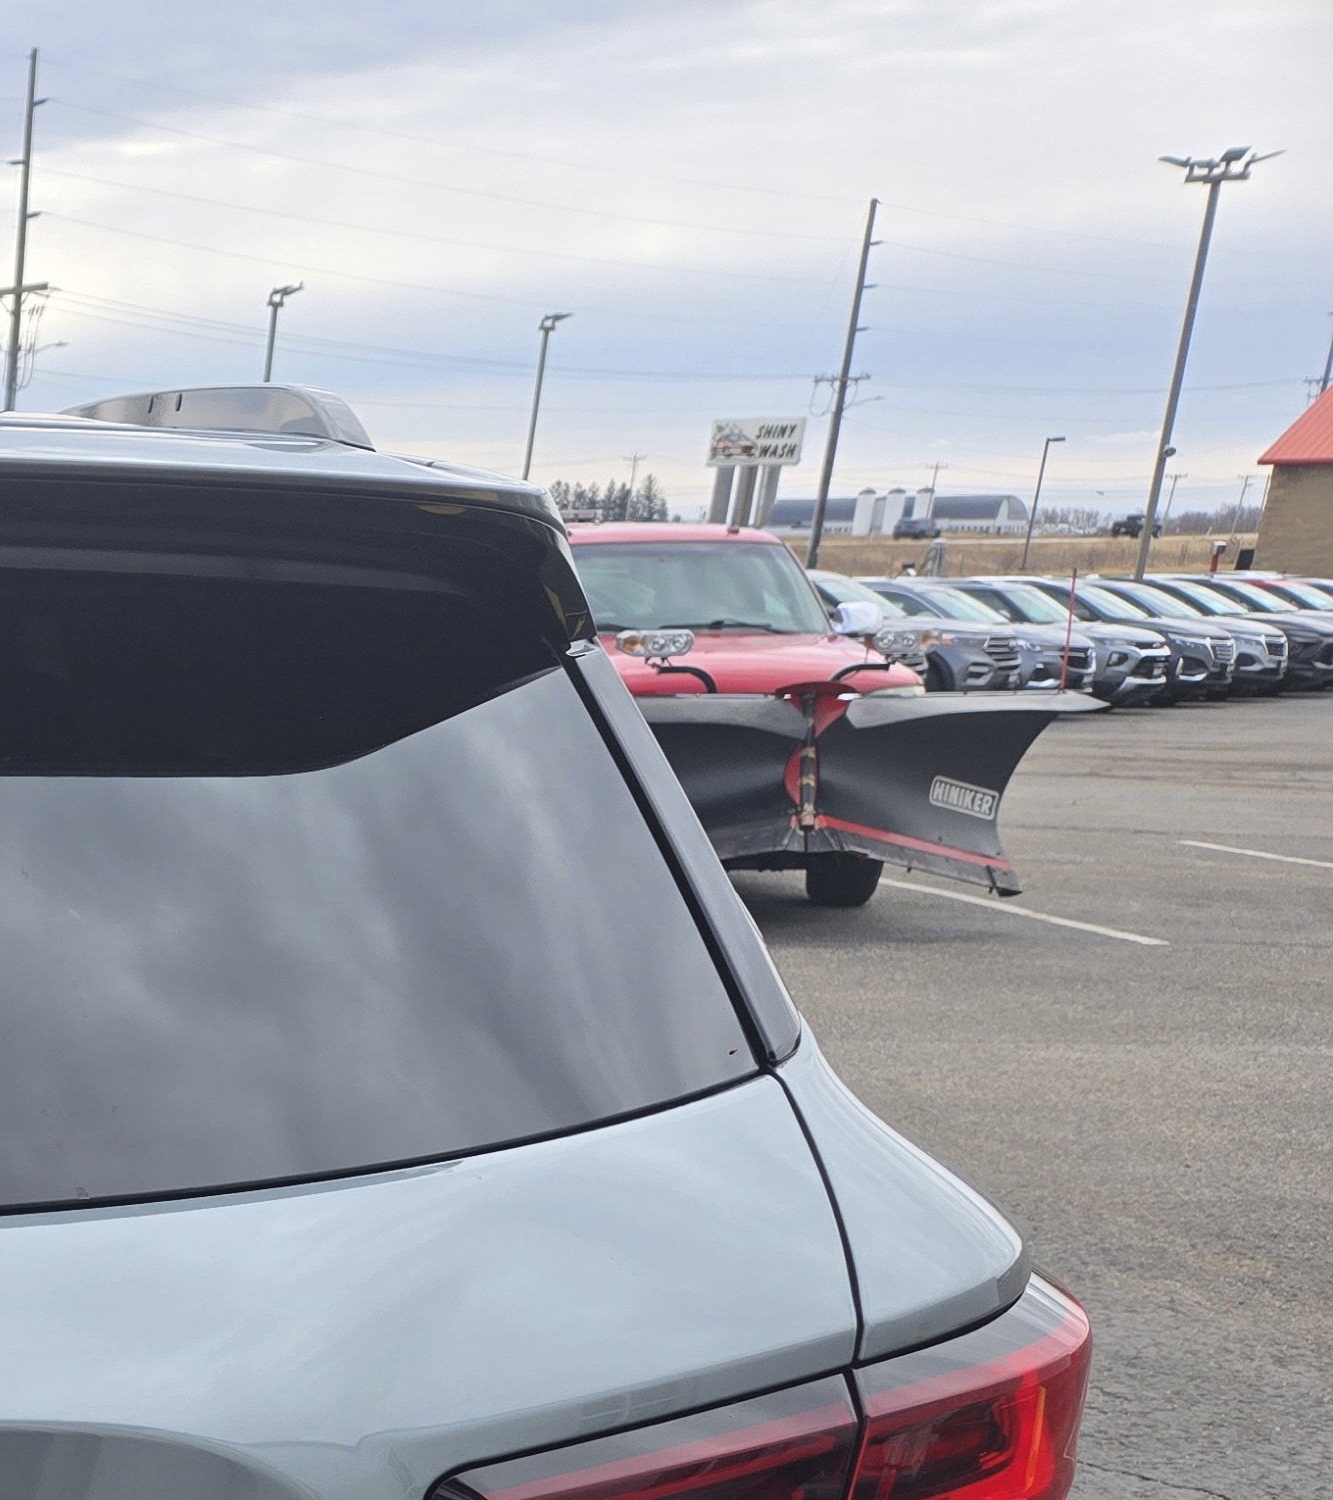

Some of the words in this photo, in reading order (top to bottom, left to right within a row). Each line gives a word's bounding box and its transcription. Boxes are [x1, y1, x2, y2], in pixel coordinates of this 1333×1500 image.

[756, 423, 796, 439] SHINY
[758, 442, 796, 458] WASH
[933, 781, 993, 815] HINIKER
